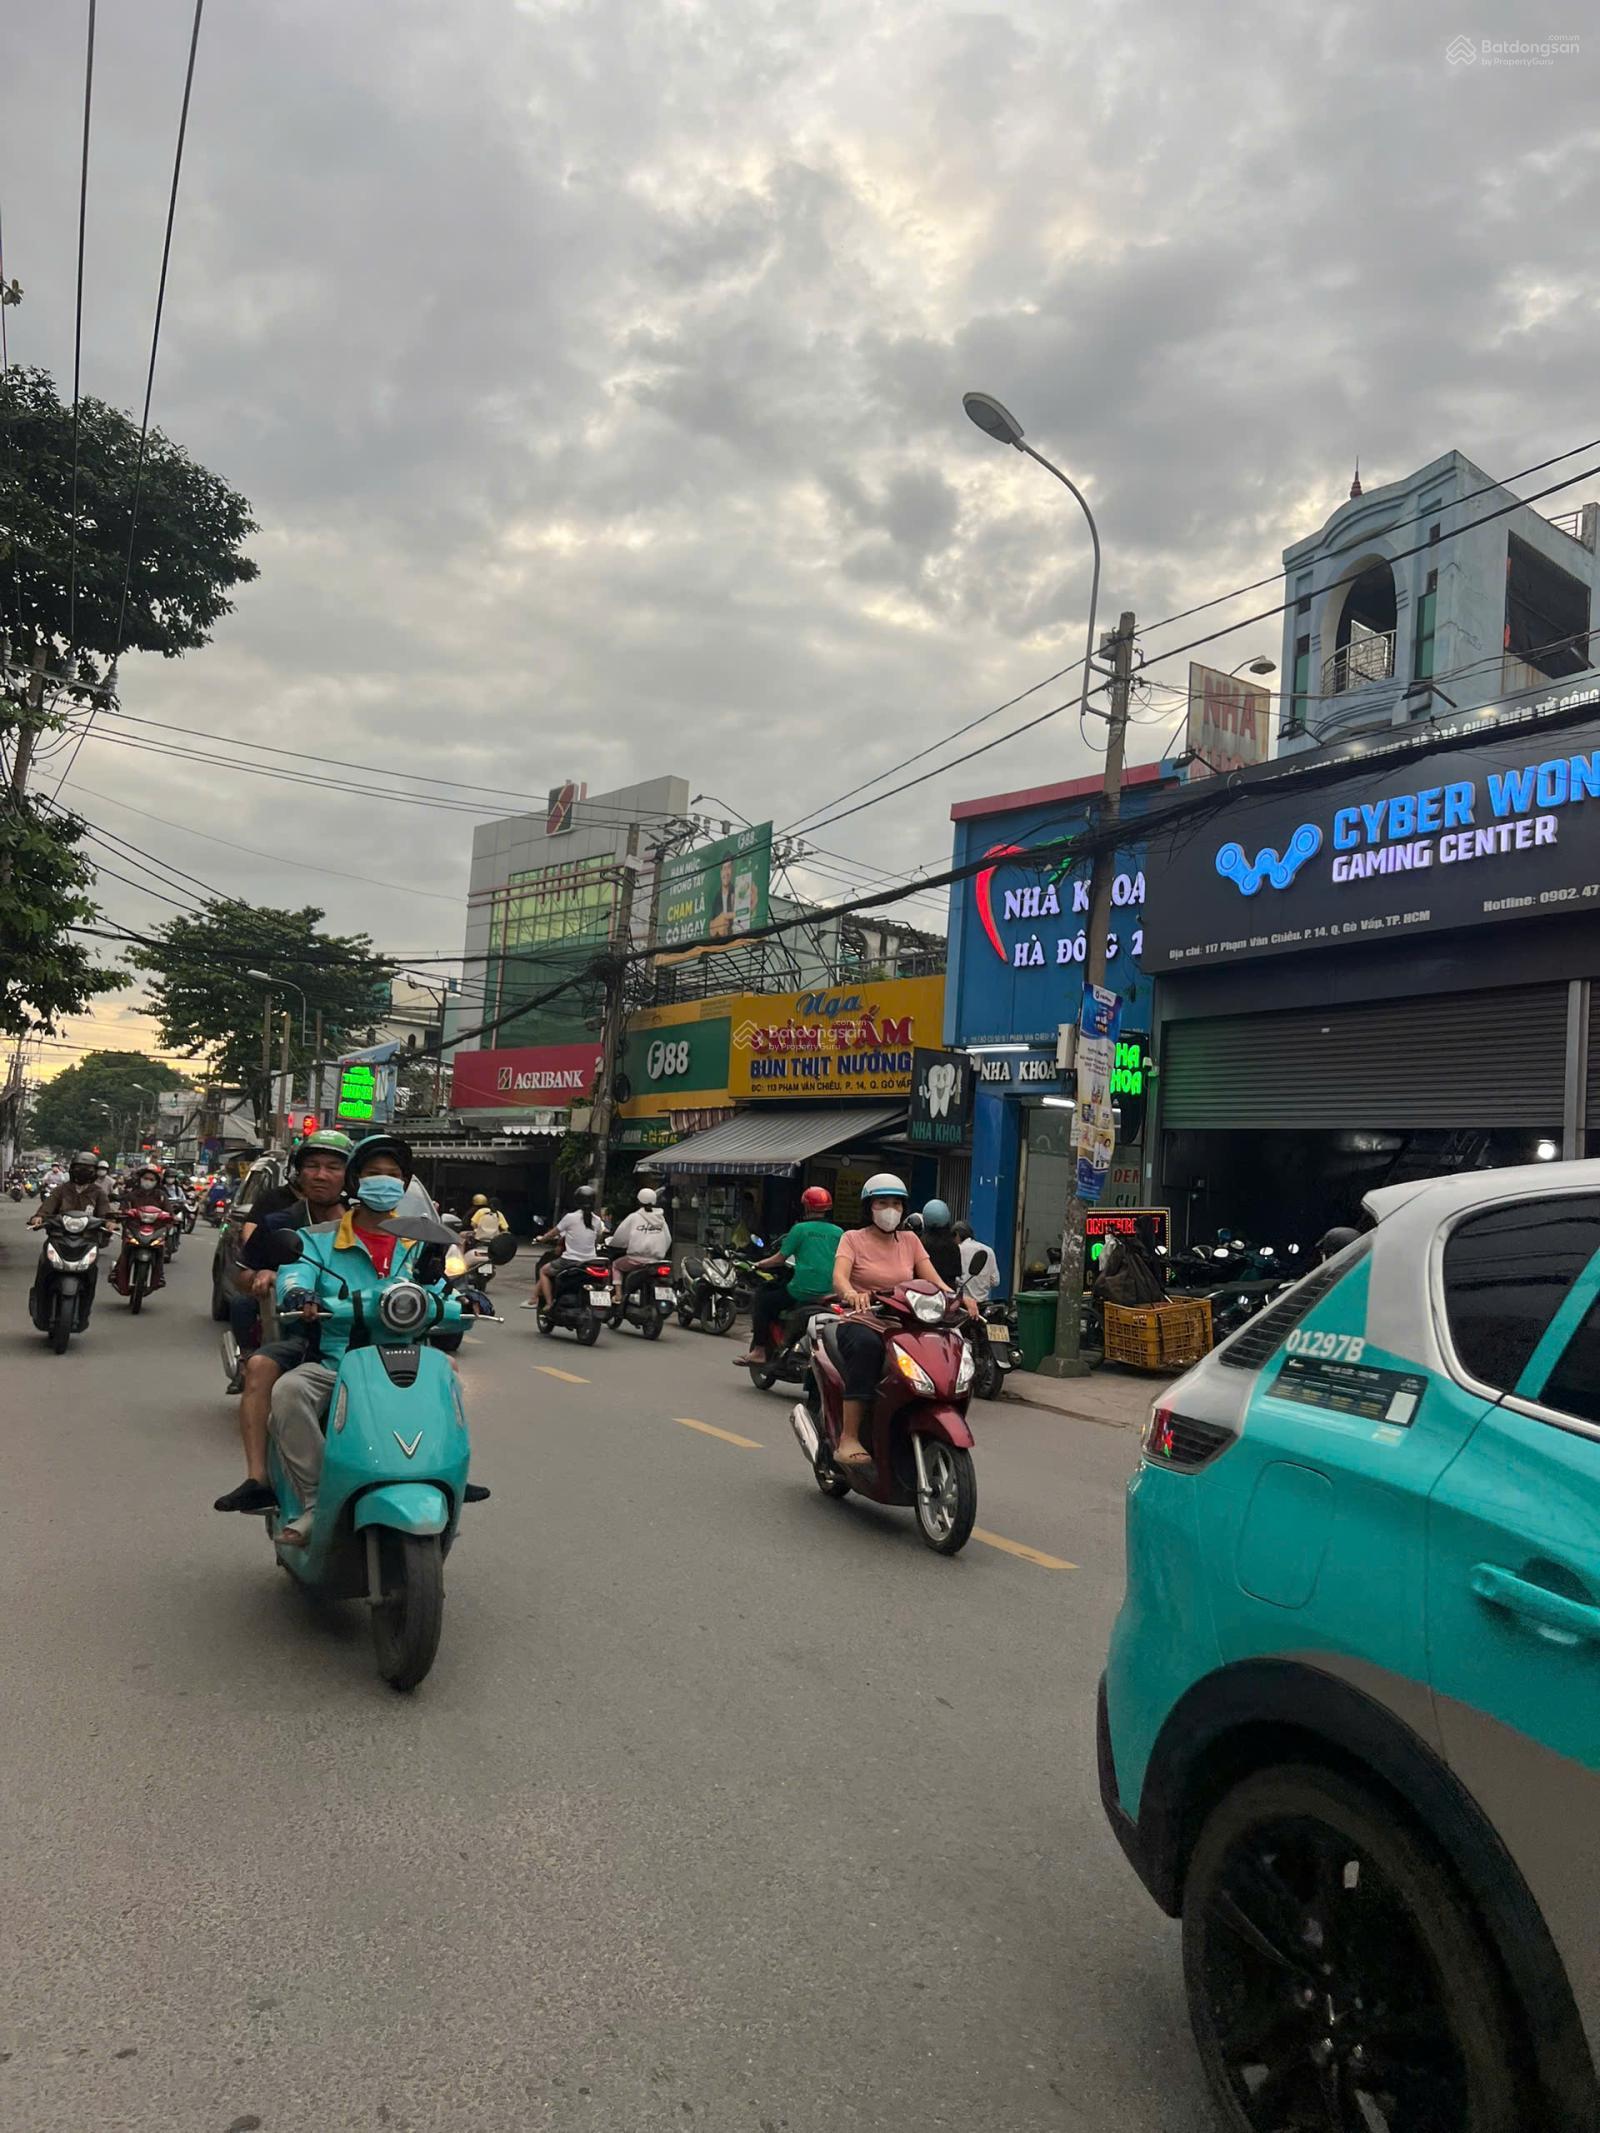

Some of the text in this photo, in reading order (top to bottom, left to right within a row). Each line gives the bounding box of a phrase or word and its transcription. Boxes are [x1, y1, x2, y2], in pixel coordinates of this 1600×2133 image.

[1333, 781, 1475, 850] CYBER
[1332, 815, 1558, 883] GAMING CENTER
[1072, 871, 1146, 912] KOA
[1483, 896, 1536, 912] Hotline:
[1205, 943, 1218, 953] 117
[1304, 929, 1312, 939] P.
[1403, 910, 1430, 923] HCM
[1013, 934, 1045, 967] HÀ
[1056, 929, 1118, 963] ĐÔG
[647, 1040, 689, 1080] F88
[791, 1057, 831, 1079] THỊT
[981, 1061, 1010, 1081] NHA
[1018, 1059, 1058, 1080] KHOA
[1114, 1043, 1140, 1068] HA
[514, 1070, 584, 1090] AGRIBANK
[767, 1084, 777, 1092] 113
[1109, 1069, 1142, 1095] HOA
[1285, 1329, 1366, 1363] 01297B
